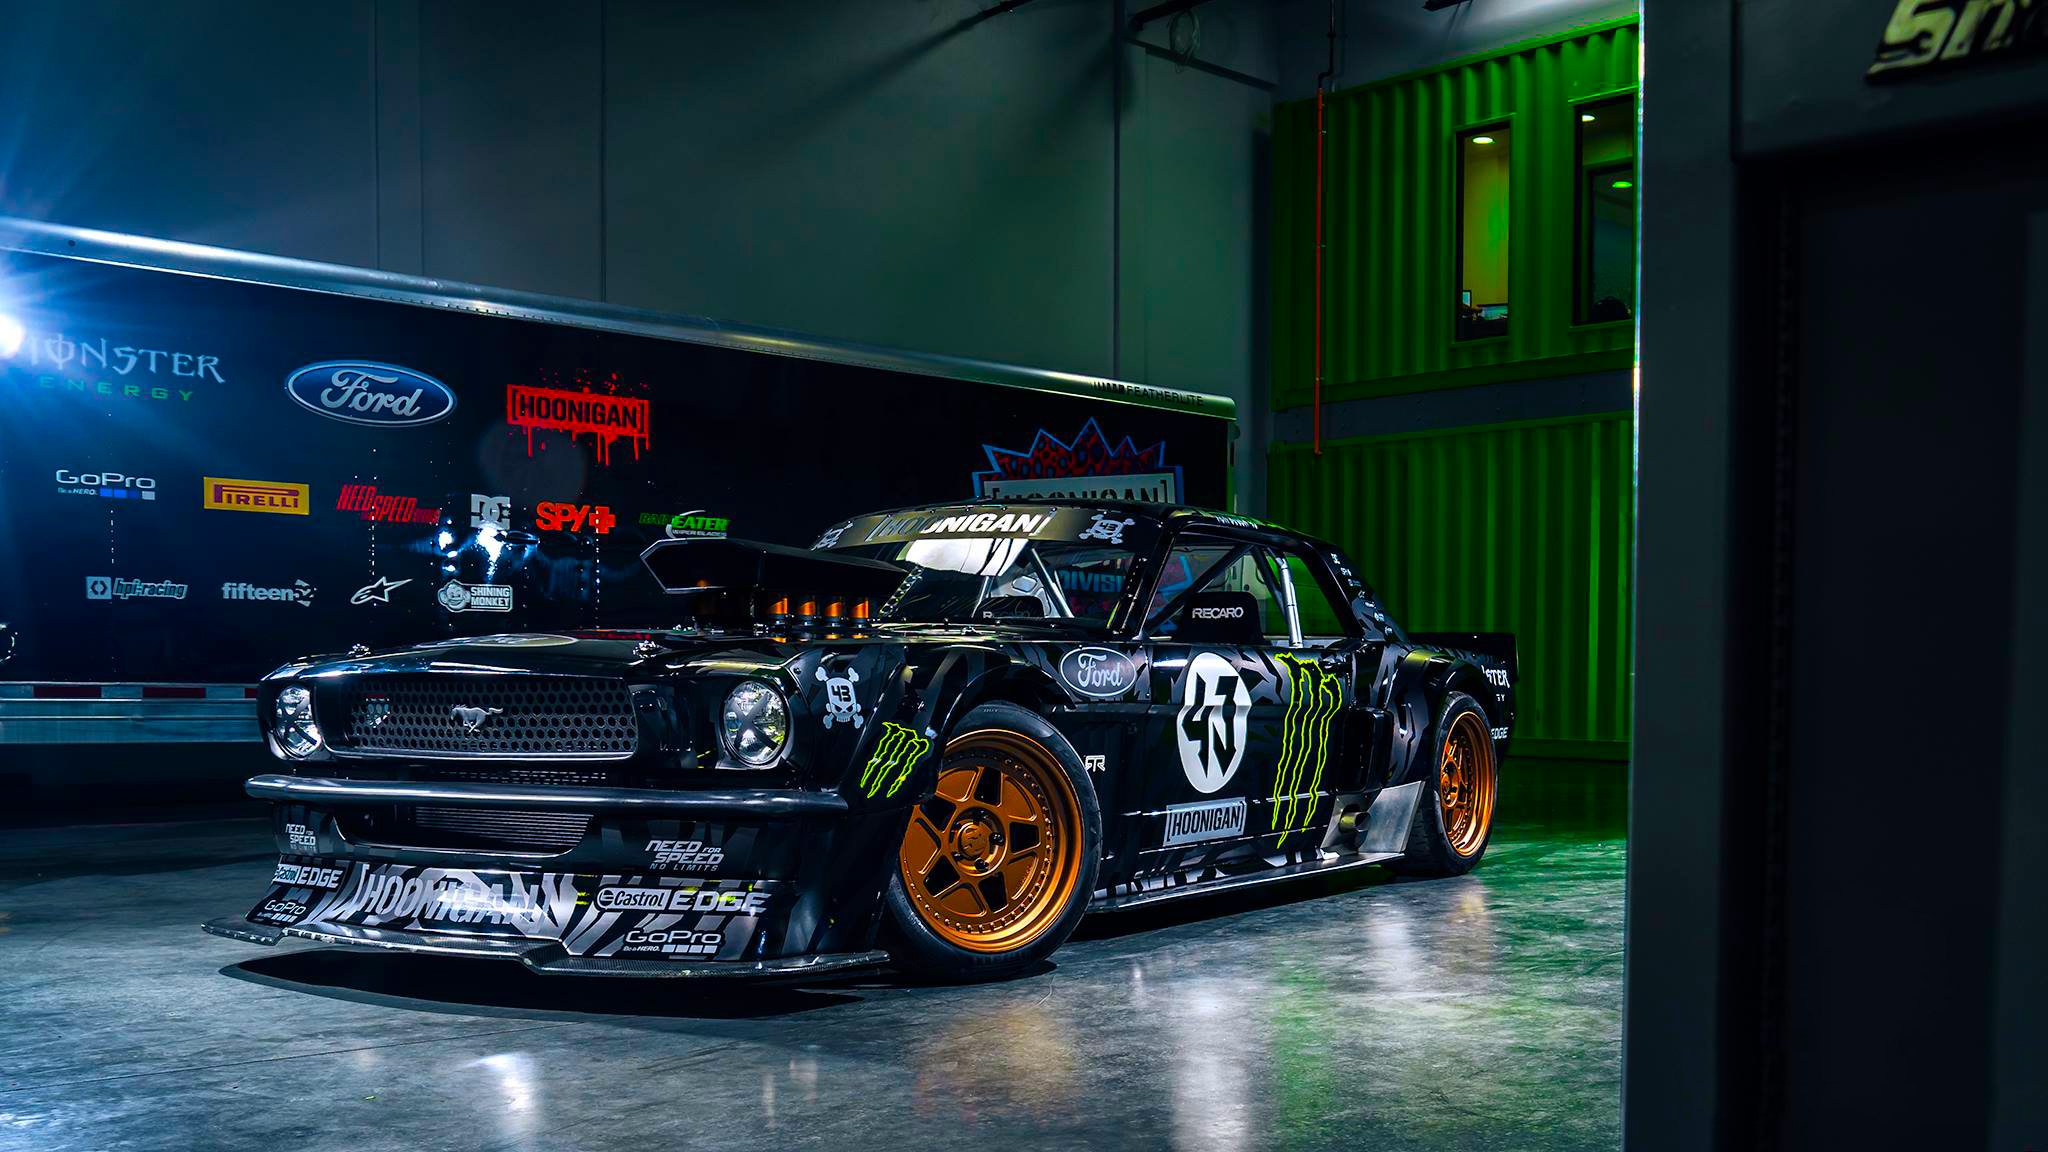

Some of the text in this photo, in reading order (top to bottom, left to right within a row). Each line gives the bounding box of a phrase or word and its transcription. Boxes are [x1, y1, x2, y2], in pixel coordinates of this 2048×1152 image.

[39, 376, 193, 401] ENERGY
[320, 369, 422, 418] Ford
[1126, 385, 1204, 406] FEATHERLITE
[56, 469, 156, 489] GoPro
[213, 483, 300, 508] PIRELLI
[336, 484, 377, 511] NEED
[368, 495, 418, 523] SPEED
[470, 586, 510, 597] SHINING
[470, 597, 510, 607] MONKEY
[1191, 606, 1244, 620] RECARO
[1077, 652, 1123, 688] Ford
[831, 685, 850, 703] 43
[285, 823, 306, 835] NEED
[289, 834, 316, 846] SPEED
[645, 840, 702, 852] NEED
[653, 852, 725, 865] SPEED
[296, 866, 344, 888] EDGE
[673, 864, 719, 872] LIMITS
[264, 899, 307, 915] GoPro
[613, 890, 772, 914] Castrol EDGE
[625, 930, 722, 944] GoPro
